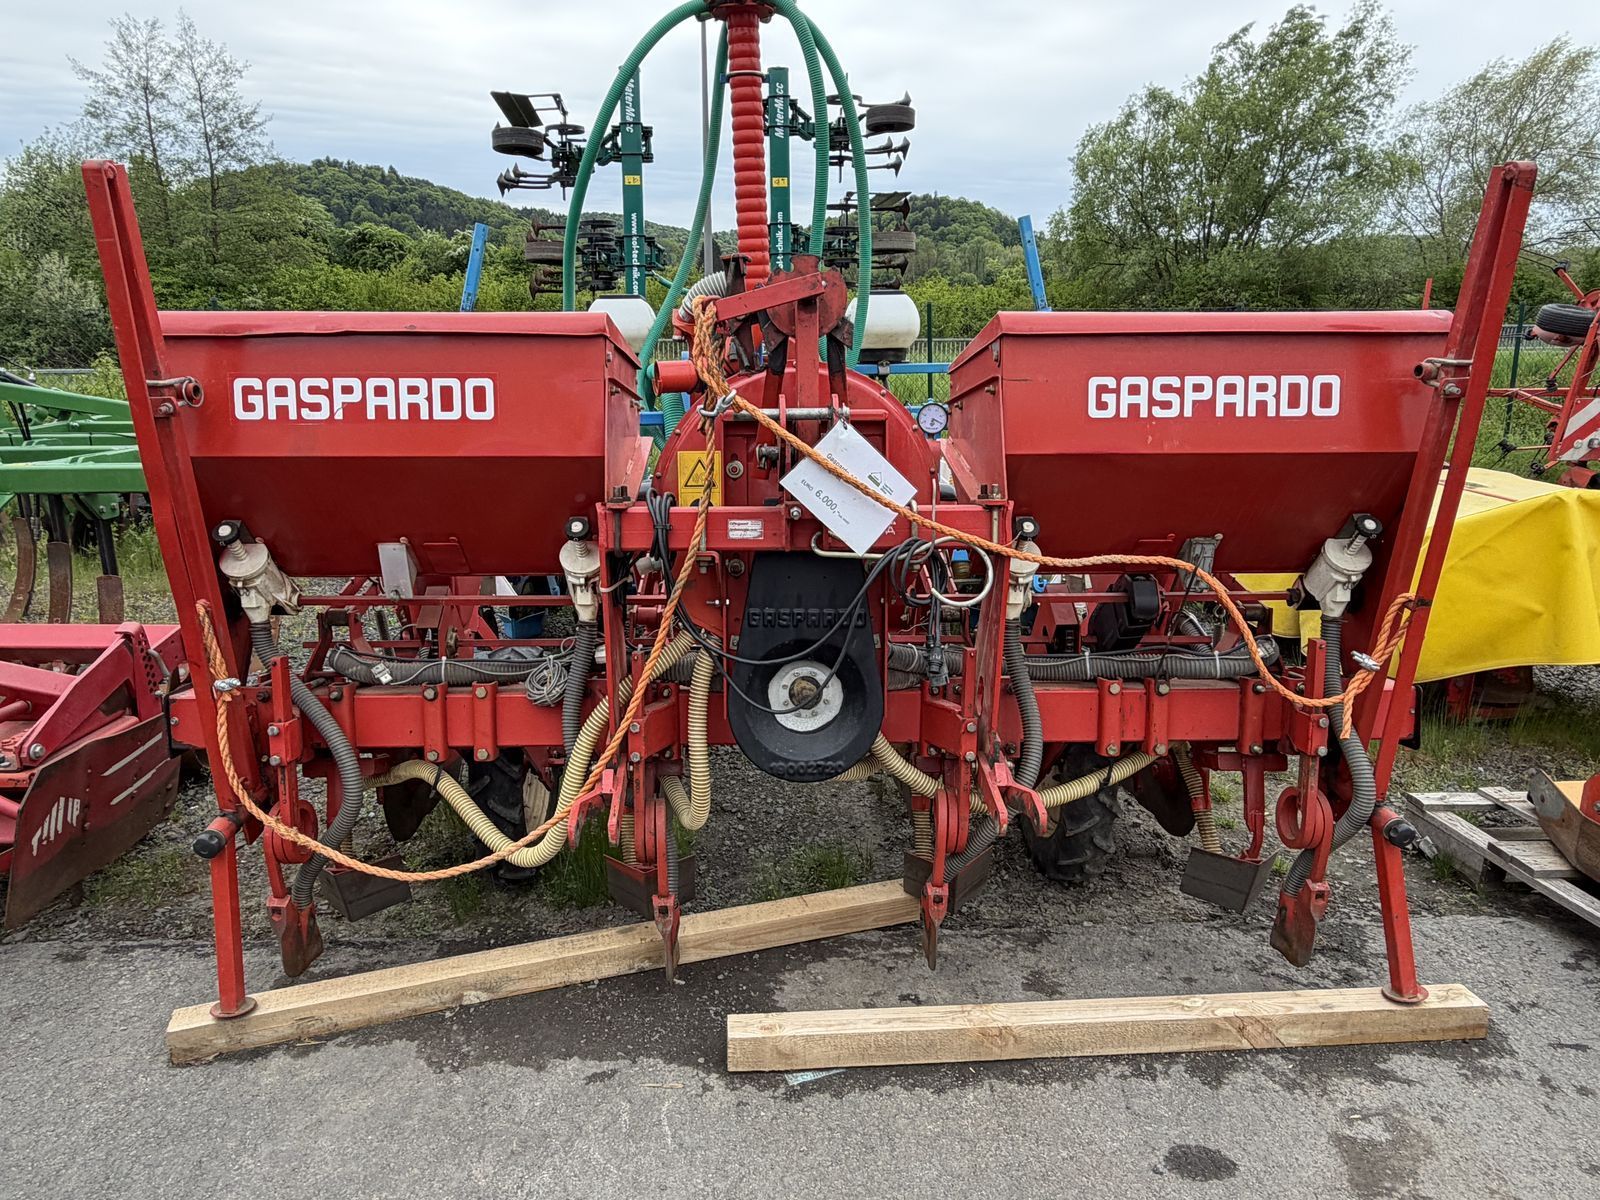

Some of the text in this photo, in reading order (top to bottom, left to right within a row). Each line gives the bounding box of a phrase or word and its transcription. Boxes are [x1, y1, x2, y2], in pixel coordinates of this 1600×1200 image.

[625, 78, 636, 133] MaterMac
[233, 377, 496, 421] GASPARDO
[1088, 374, 1341, 419] GASPARDO
[747, 607, 867, 628] GASPARDO
